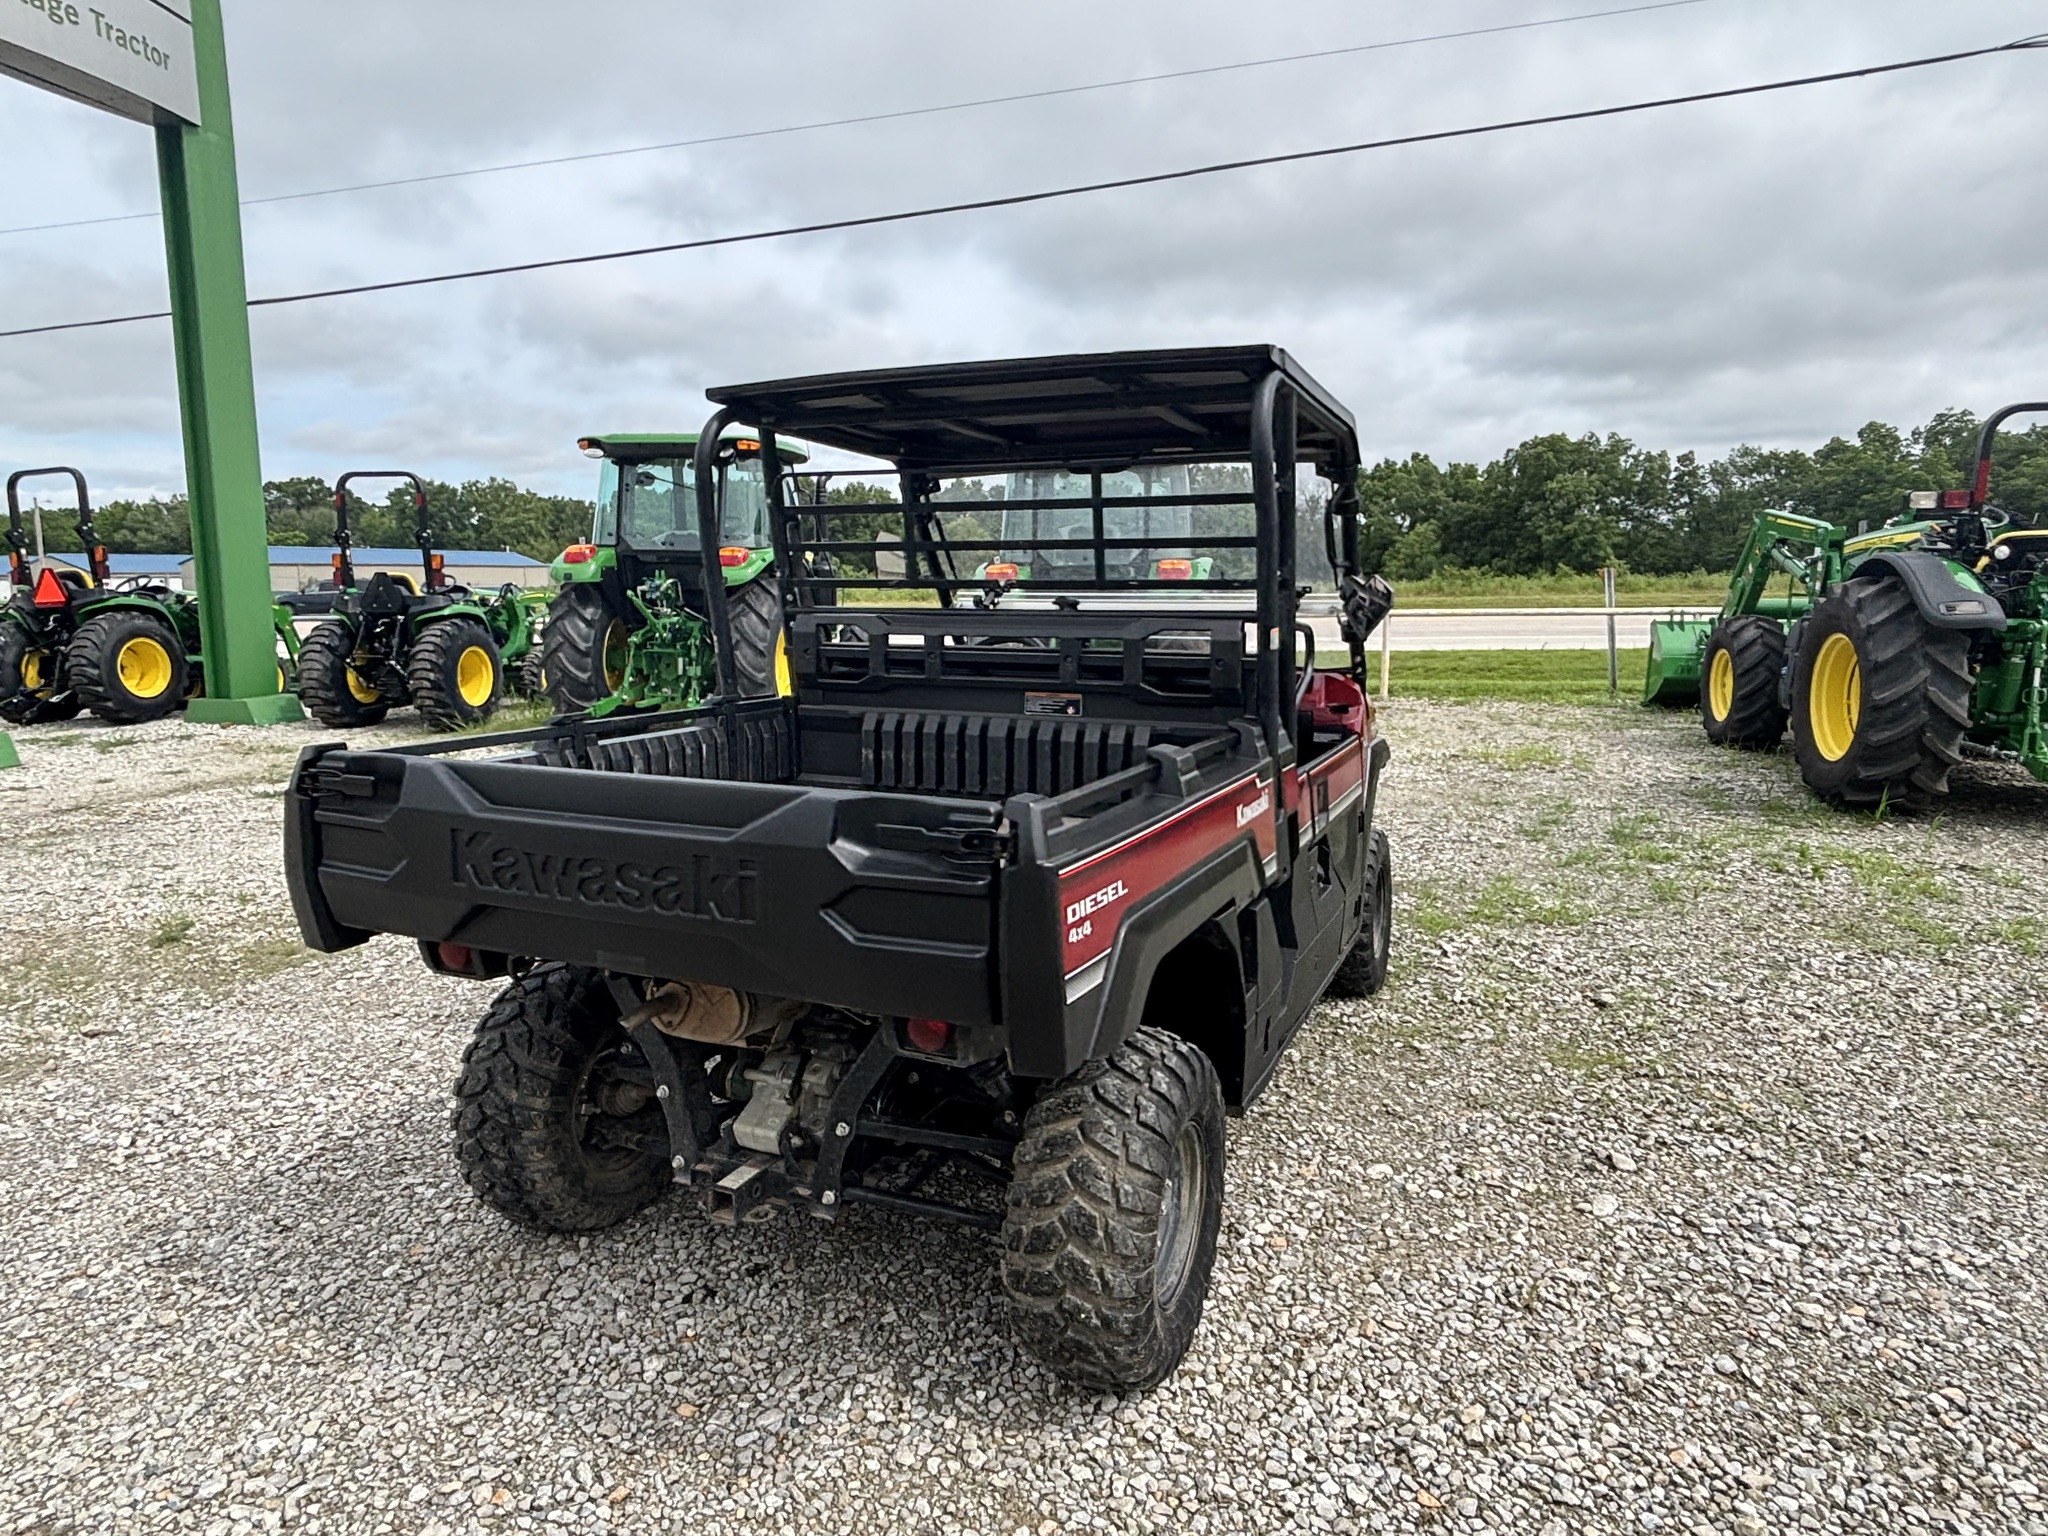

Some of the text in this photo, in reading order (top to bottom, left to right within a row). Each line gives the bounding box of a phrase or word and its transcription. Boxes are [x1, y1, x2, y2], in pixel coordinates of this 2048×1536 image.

[22, 0, 171, 71] age Tractor
[450, 827, 757, 924] Kawasaki
[1066, 879, 1129, 925] DIESEL
[1068, 920, 1093, 943] 4x4
